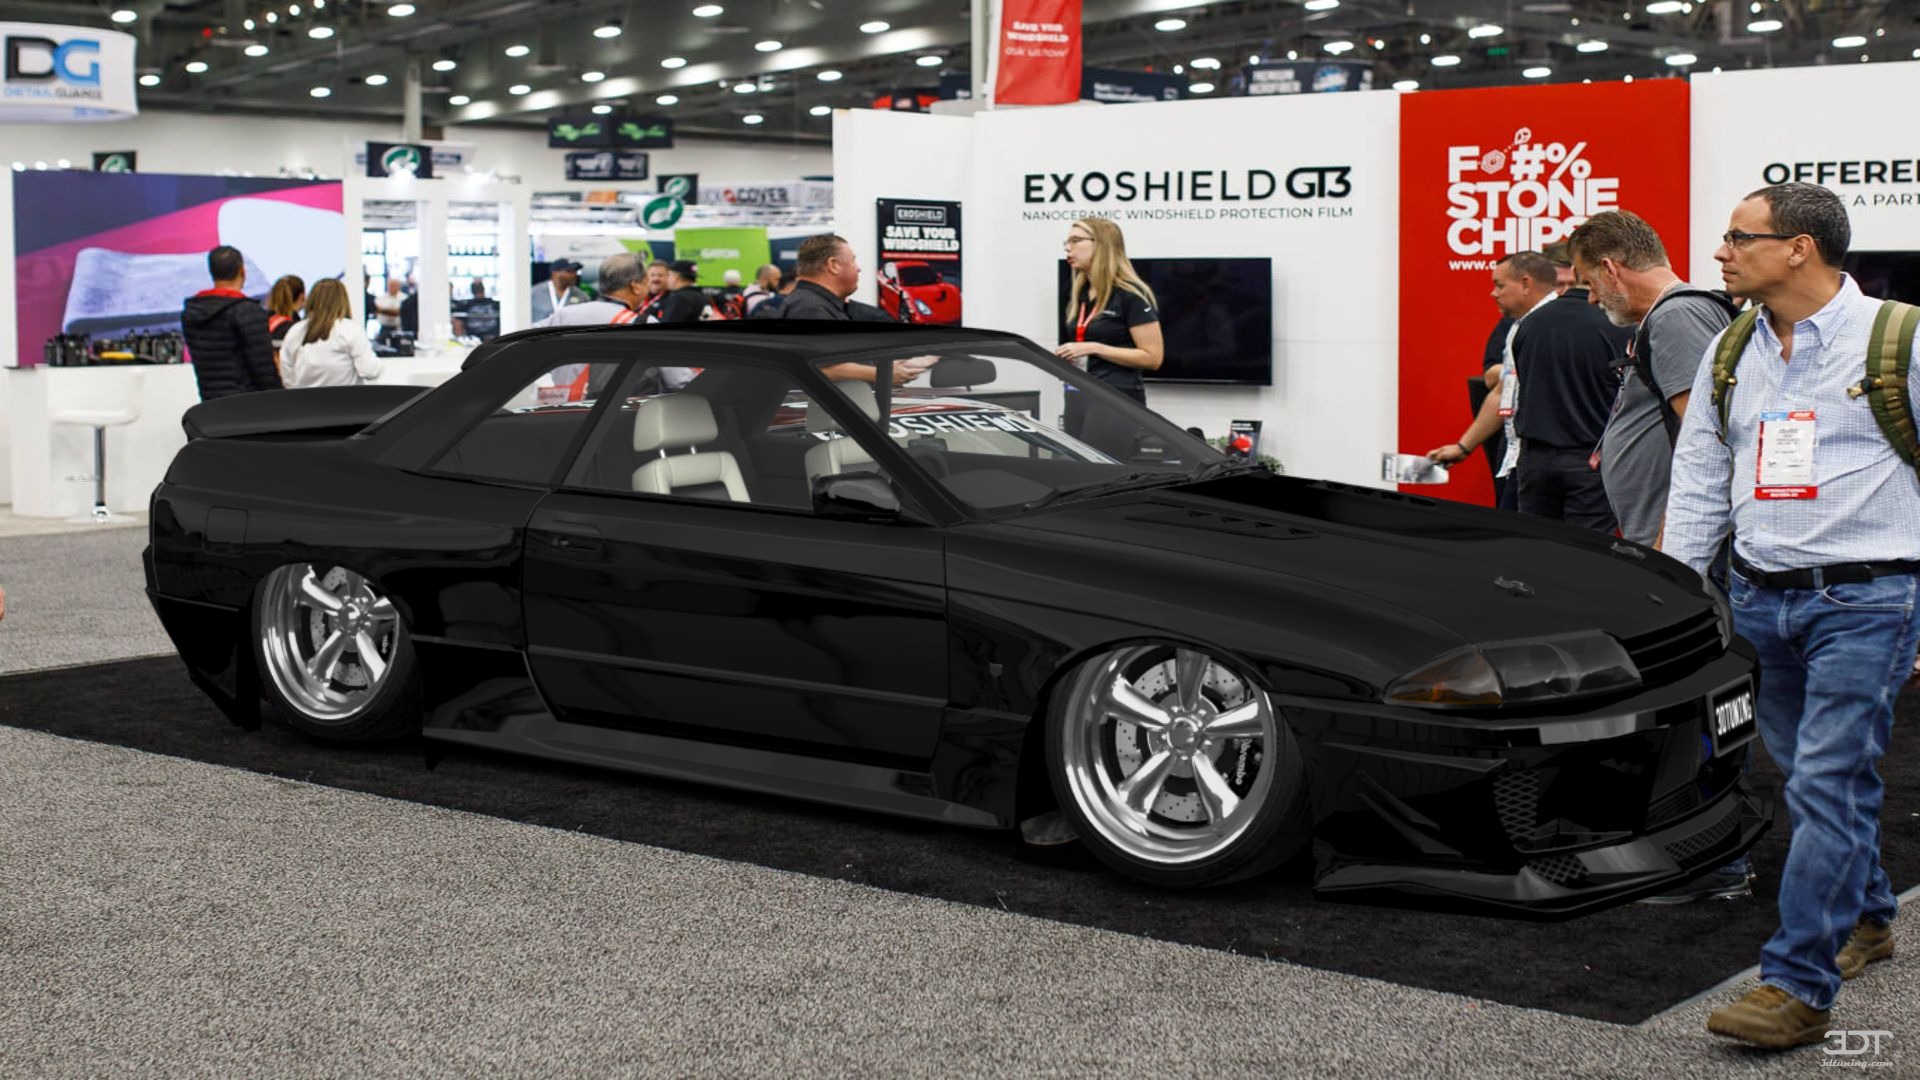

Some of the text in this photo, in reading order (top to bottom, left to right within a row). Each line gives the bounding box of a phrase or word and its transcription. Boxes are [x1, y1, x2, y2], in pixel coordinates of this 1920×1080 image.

[1013, 21, 1063, 32] SAVE YOUR
[1007, 31, 1069, 43] WINDSHIELD
[4, 36, 100, 84] DG
[1763, 159, 1920, 185] OFFERE
[1024, 165, 1352, 203] EXOSHIELD GT3
[737, 187, 789, 203] COVER
[1446, 177, 1619, 219] STONE
[1853, 194, 1866, 206] A
[898, 209, 943, 219] EXOSHIELD
[1023, 206, 1353, 221] NANOCERAMIC WINDSHIELD PROTECTION FILM
[886, 225, 956, 239] SAVE YOUR
[883, 238, 960, 251] WINDSHIELD
[1716, 692, 1751, 736] 3DTUNING
